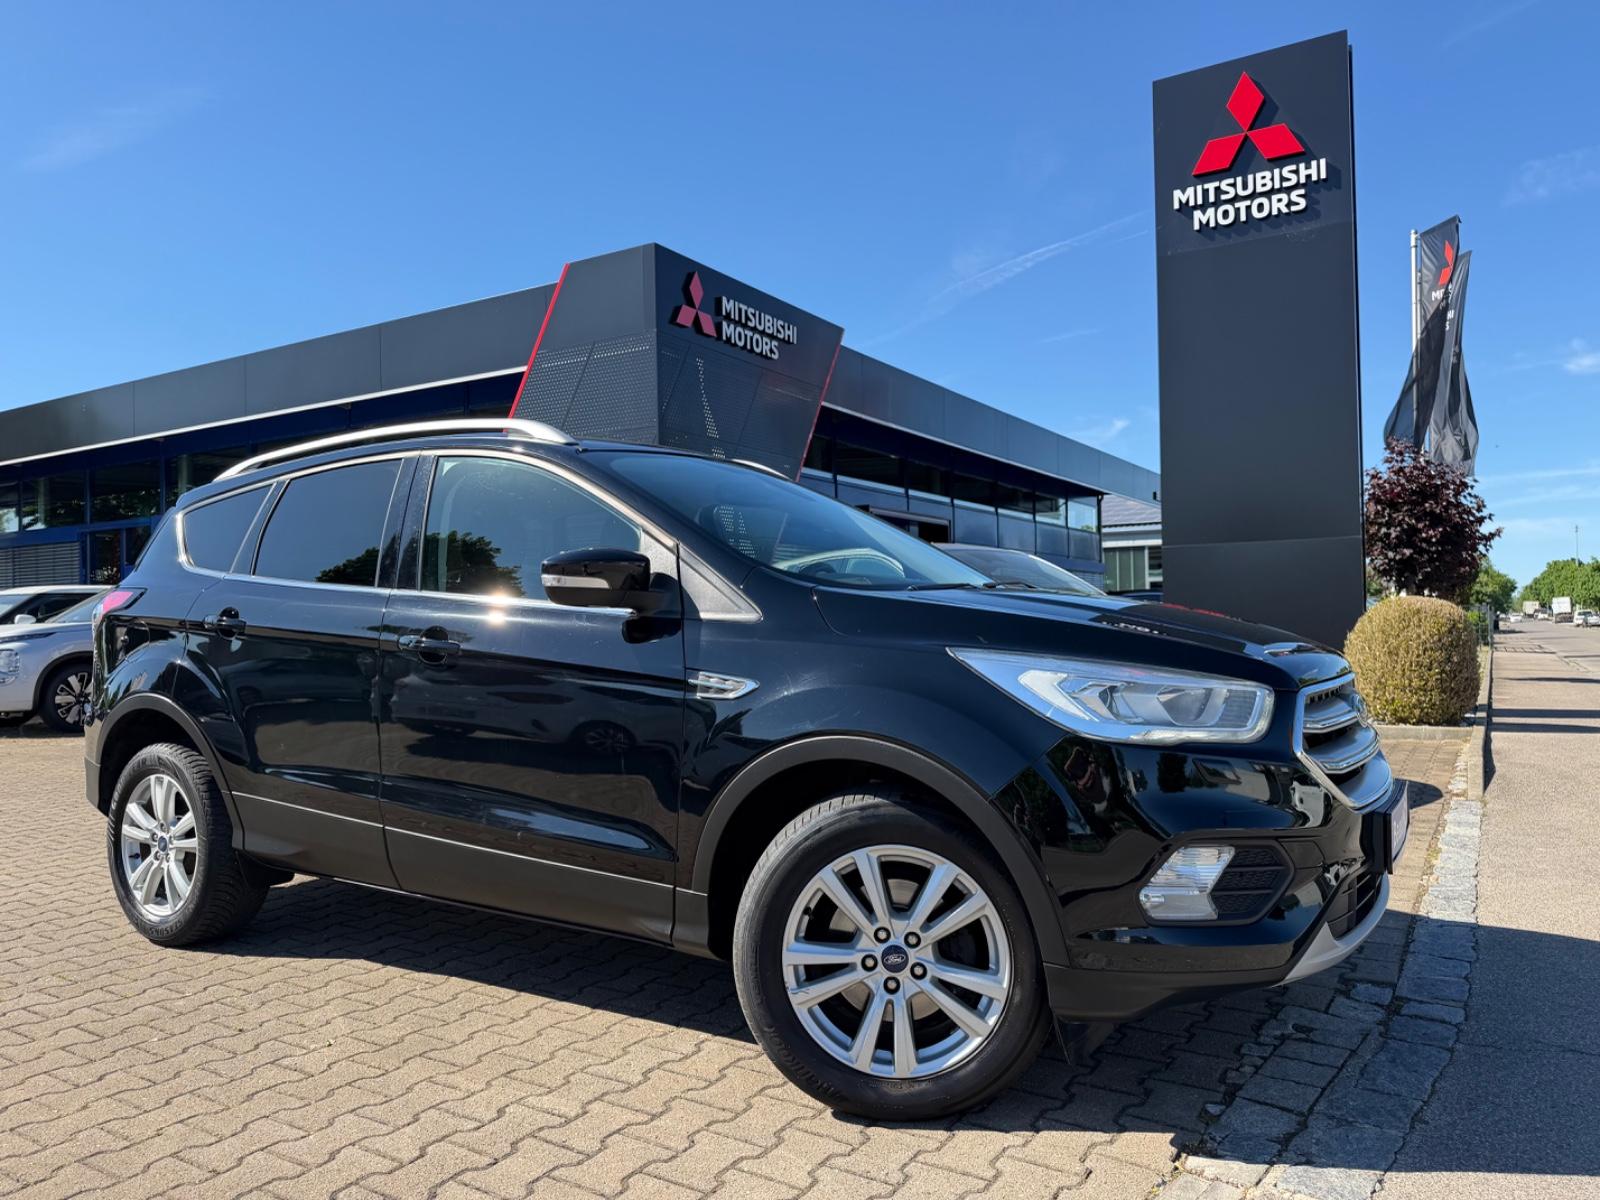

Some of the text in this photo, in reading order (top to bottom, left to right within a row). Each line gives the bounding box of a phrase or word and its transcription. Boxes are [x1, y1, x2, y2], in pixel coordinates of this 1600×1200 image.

[1173, 158, 1326, 210] MITSUBISHI
[1193, 189, 1307, 230] MOTORS
[722, 296, 797, 344] MITSUBISHI
[722, 321, 779, 360] MOTORS
